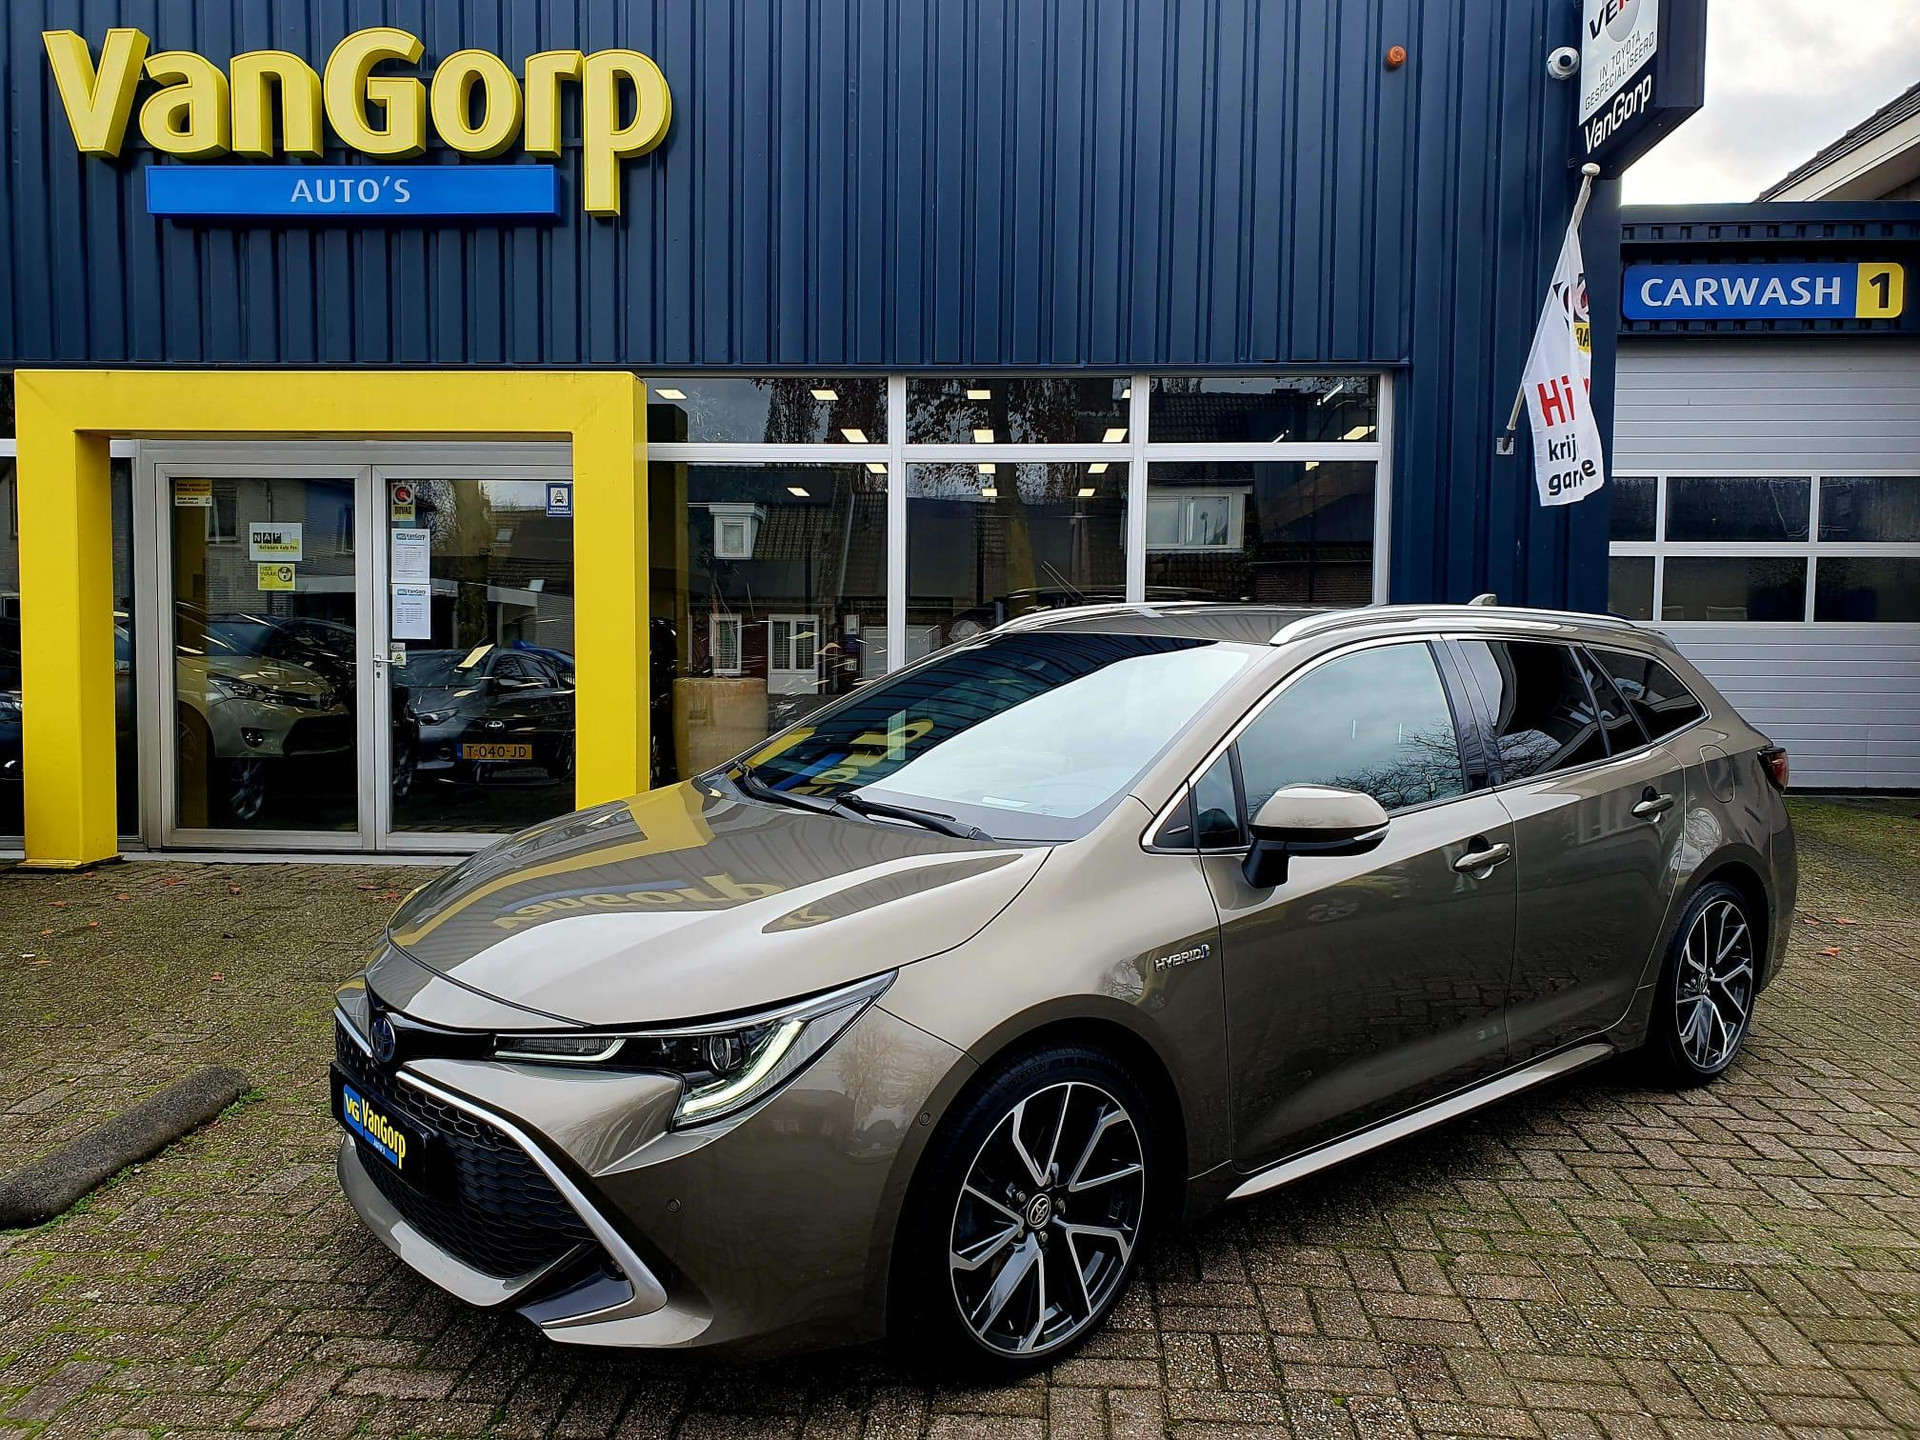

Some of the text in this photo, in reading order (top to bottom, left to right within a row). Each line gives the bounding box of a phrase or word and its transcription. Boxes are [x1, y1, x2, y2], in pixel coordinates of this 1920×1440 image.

[1585, 31, 1654, 111] GESPECIALISEERD
[1600, 30, 1641, 82] IN TOYOTA
[42, 27, 672, 217] VanGorp
[1585, 74, 1652, 154] VanGorp
[291, 177, 411, 204] AUTO'S
[1640, 272, 1890, 309] CARWASH 1
[1538, 375, 1575, 427] Hi
[253, 531, 282, 544] NAP
[1155, 949, 1202, 972] HYBRID
[344, 1093, 407, 1170] VG VanGorp
